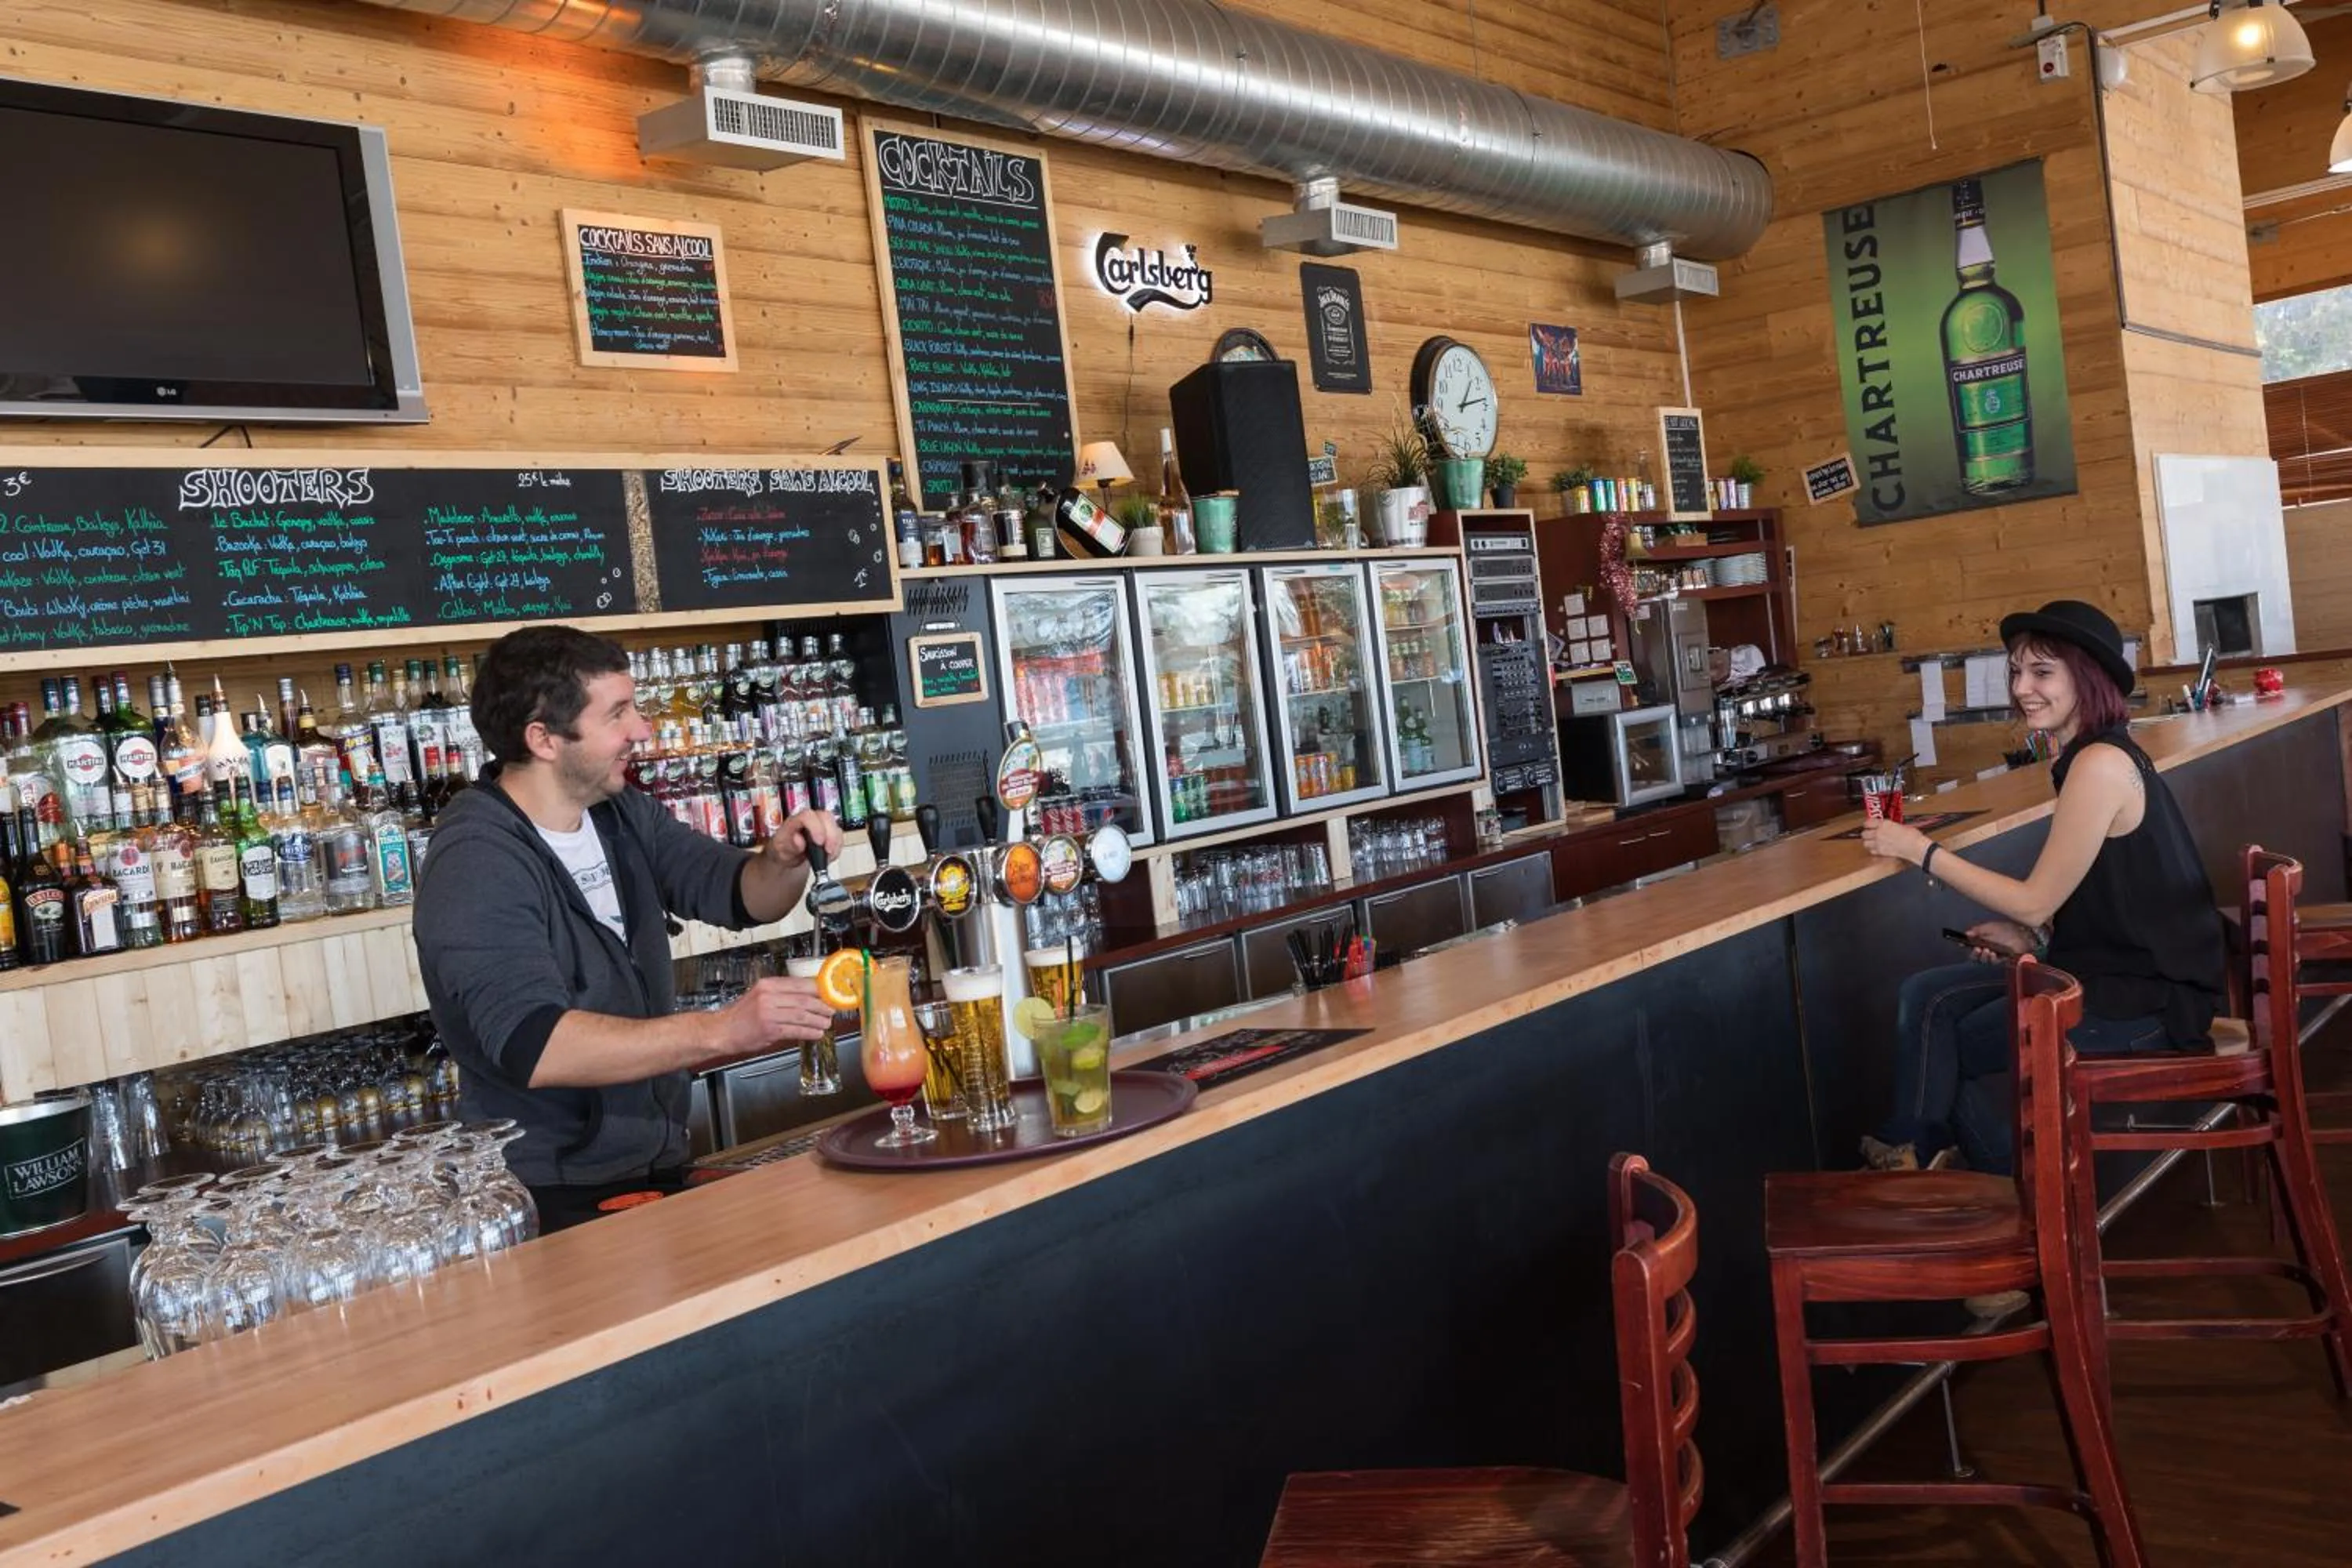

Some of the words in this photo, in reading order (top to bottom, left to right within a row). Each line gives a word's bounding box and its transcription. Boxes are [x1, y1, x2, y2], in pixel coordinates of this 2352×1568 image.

[879, 136, 1034, 203] COCKTAILS
[580, 228, 644, 253] COCKTAILS
[645, 233, 673, 255] SANS
[674, 235, 712, 260] ALCOOL
[1095, 232, 1213, 308] Carlsberg
[1842, 205, 1906, 511] CHARTREUSE
[1953, 358, 2024, 383] CHARTREUSE
[3, 471, 32, 496] 3€
[179, 469, 374, 511] SHOOTERS
[661, 468, 764, 497] SHOOTERS
[818, 470, 876, 495] ALCOOL
[2, 542, 30, 562] cool
[112, 865, 151, 877] BACARDI
[874, 888, 912, 911] Carlsberg
[13, 1146, 79, 1179] WILLIAM
